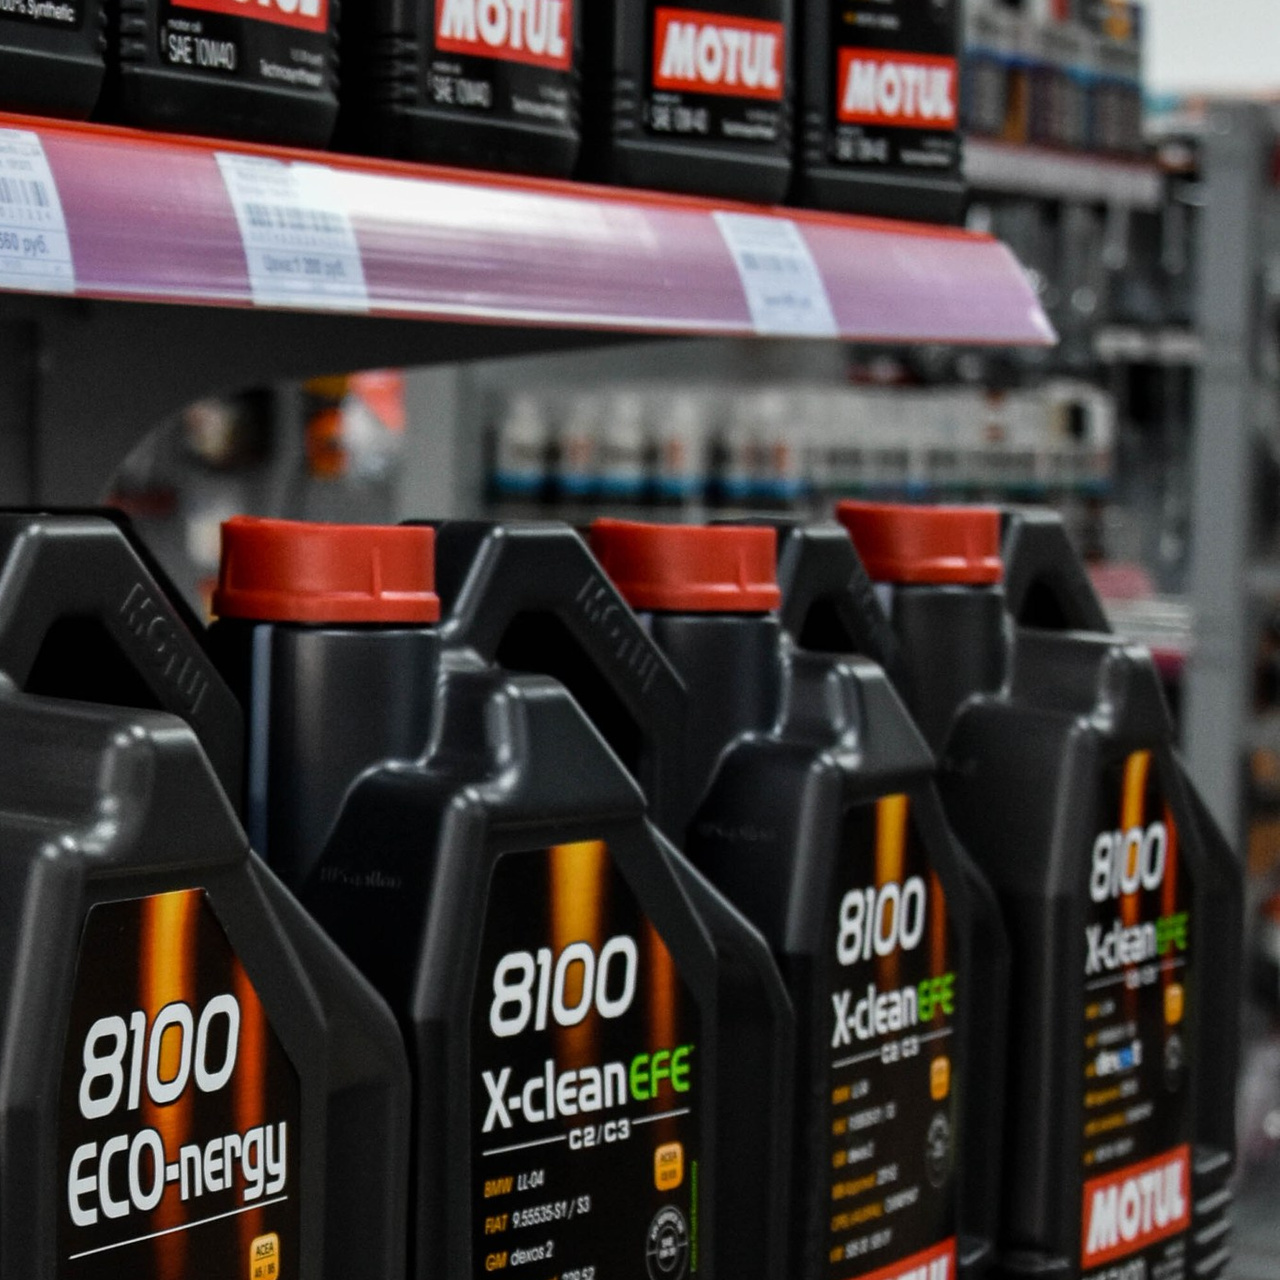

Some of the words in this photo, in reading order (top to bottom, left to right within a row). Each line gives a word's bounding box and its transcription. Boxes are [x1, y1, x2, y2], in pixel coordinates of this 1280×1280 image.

[169, 34, 192, 66] SAE
[660, 21, 779, 87] MOTUL
[843, 61, 954, 120] MOTUL
[22, 234, 50, 257] руб.
[1090, 822, 1166, 902] 8100
[836, 876, 926, 966] 8100
[490, 934, 638, 1038] 8100
[79, 994, 240, 1119] 8100
[569, 1119, 630, 1150] C2/C3
[68, 1121, 286, 1227] ECO-nergy
[484, 1176, 513, 1198] BMW
[517, 1170, 545, 1191] LL-04
[485, 1214, 508, 1235] FIAT
[512, 1201, 567, 1229] 9.55535-S1
[1086, 1159, 1185, 1256] MOTUL
[485, 1251, 508, 1271] GM
